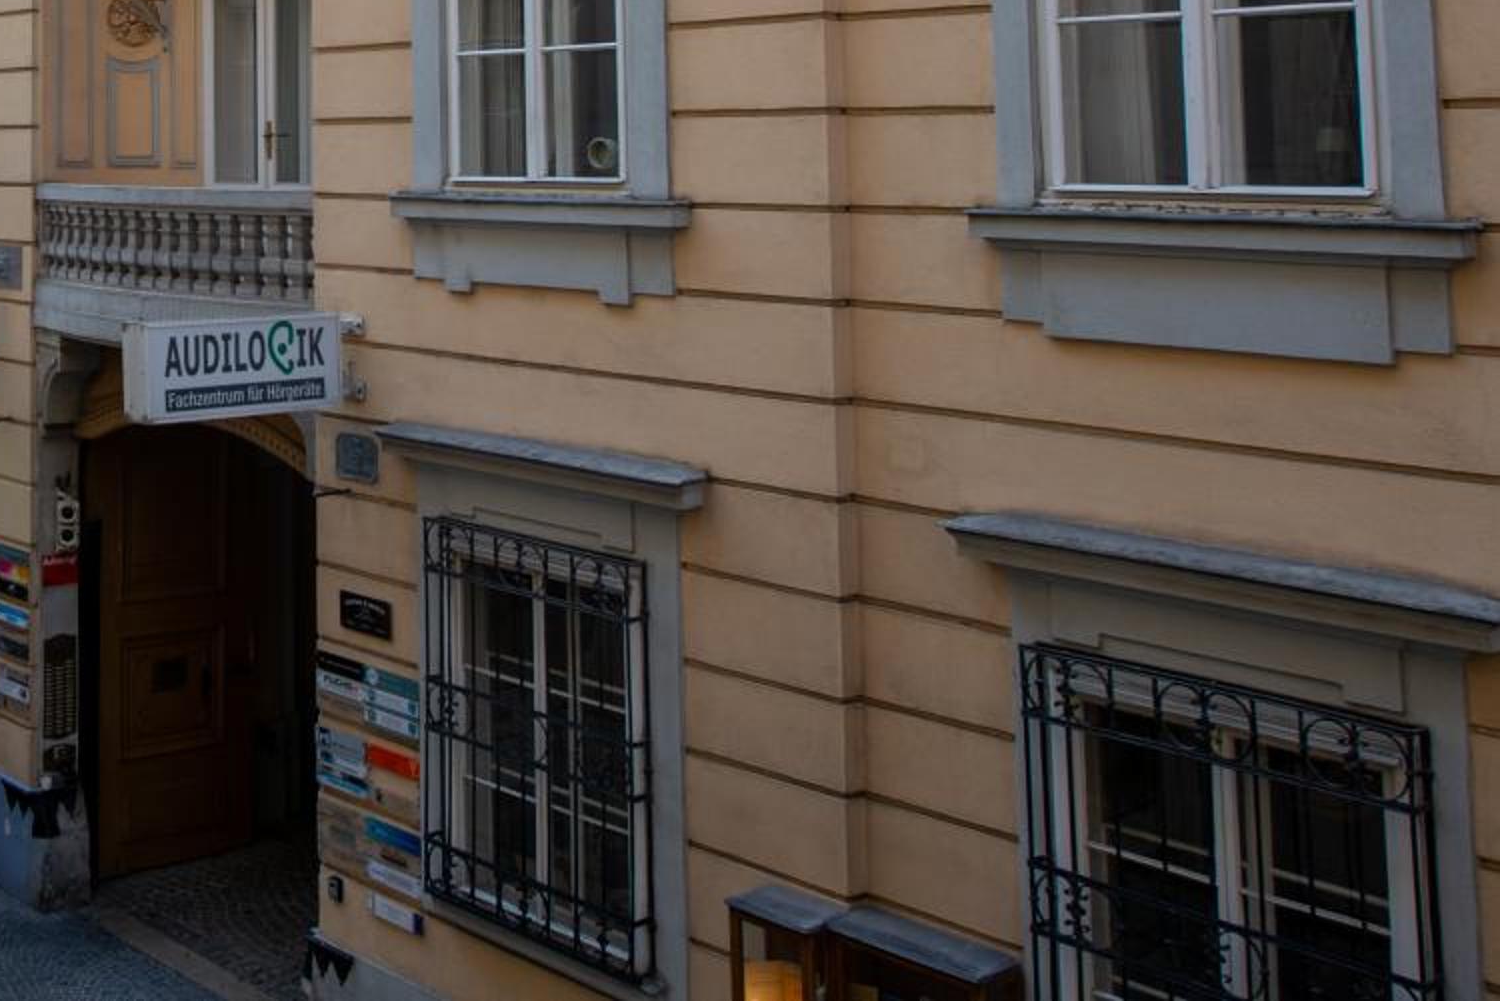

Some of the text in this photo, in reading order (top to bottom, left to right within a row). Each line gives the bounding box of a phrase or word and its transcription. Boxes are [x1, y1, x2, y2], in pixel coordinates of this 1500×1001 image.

[167, 380, 323, 410] Fachzentrum für Hörgeräte
